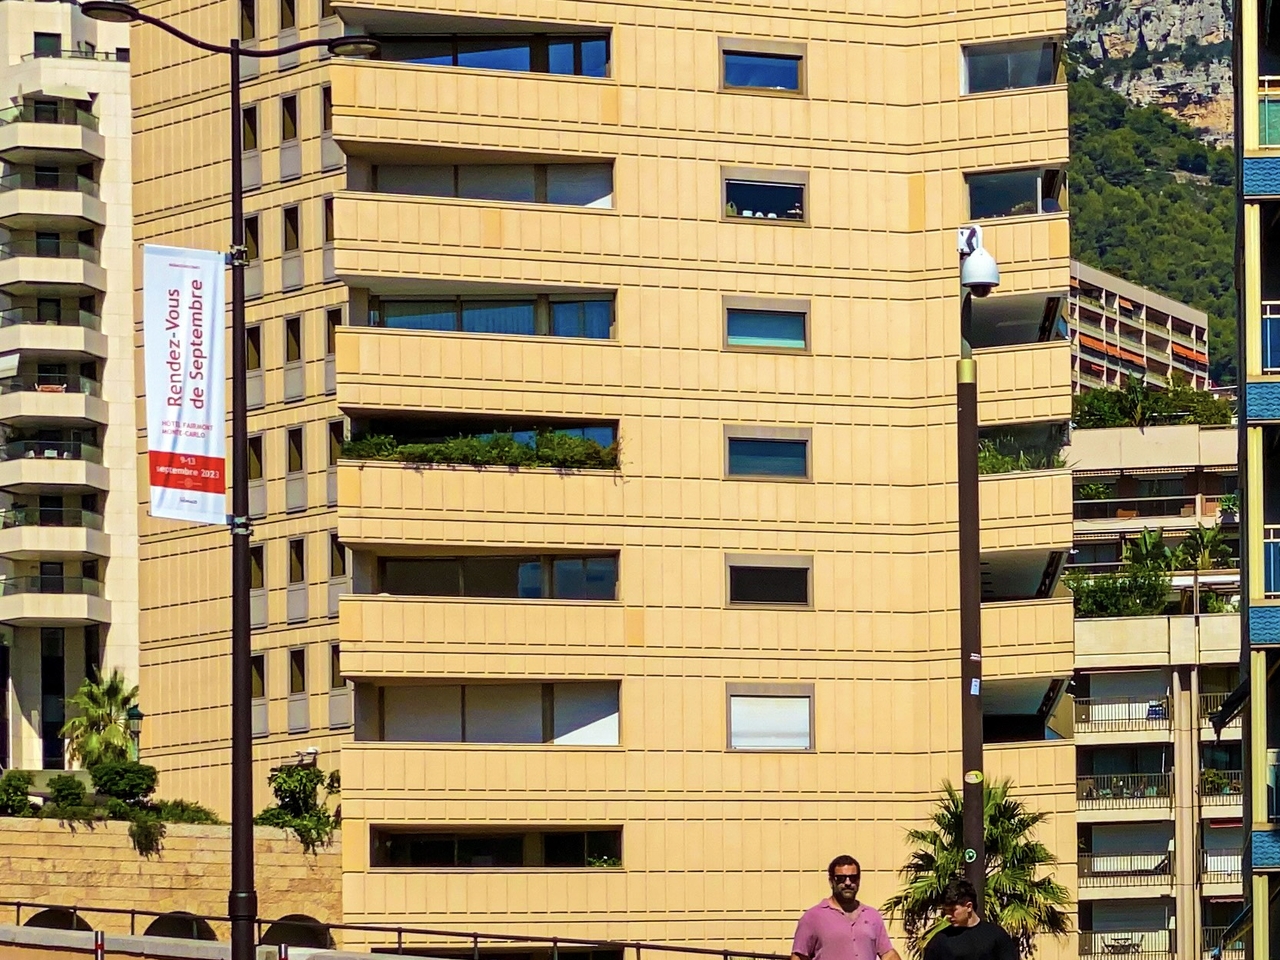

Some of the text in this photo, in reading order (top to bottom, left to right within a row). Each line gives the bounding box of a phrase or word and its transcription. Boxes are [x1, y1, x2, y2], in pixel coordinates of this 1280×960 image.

[165, 289, 182, 407] Rendez-Vous
[188, 280, 207, 409] de Septembre
[156, 466, 219, 478] septembre 2023
[179, 456, 196, 465] 9-13
